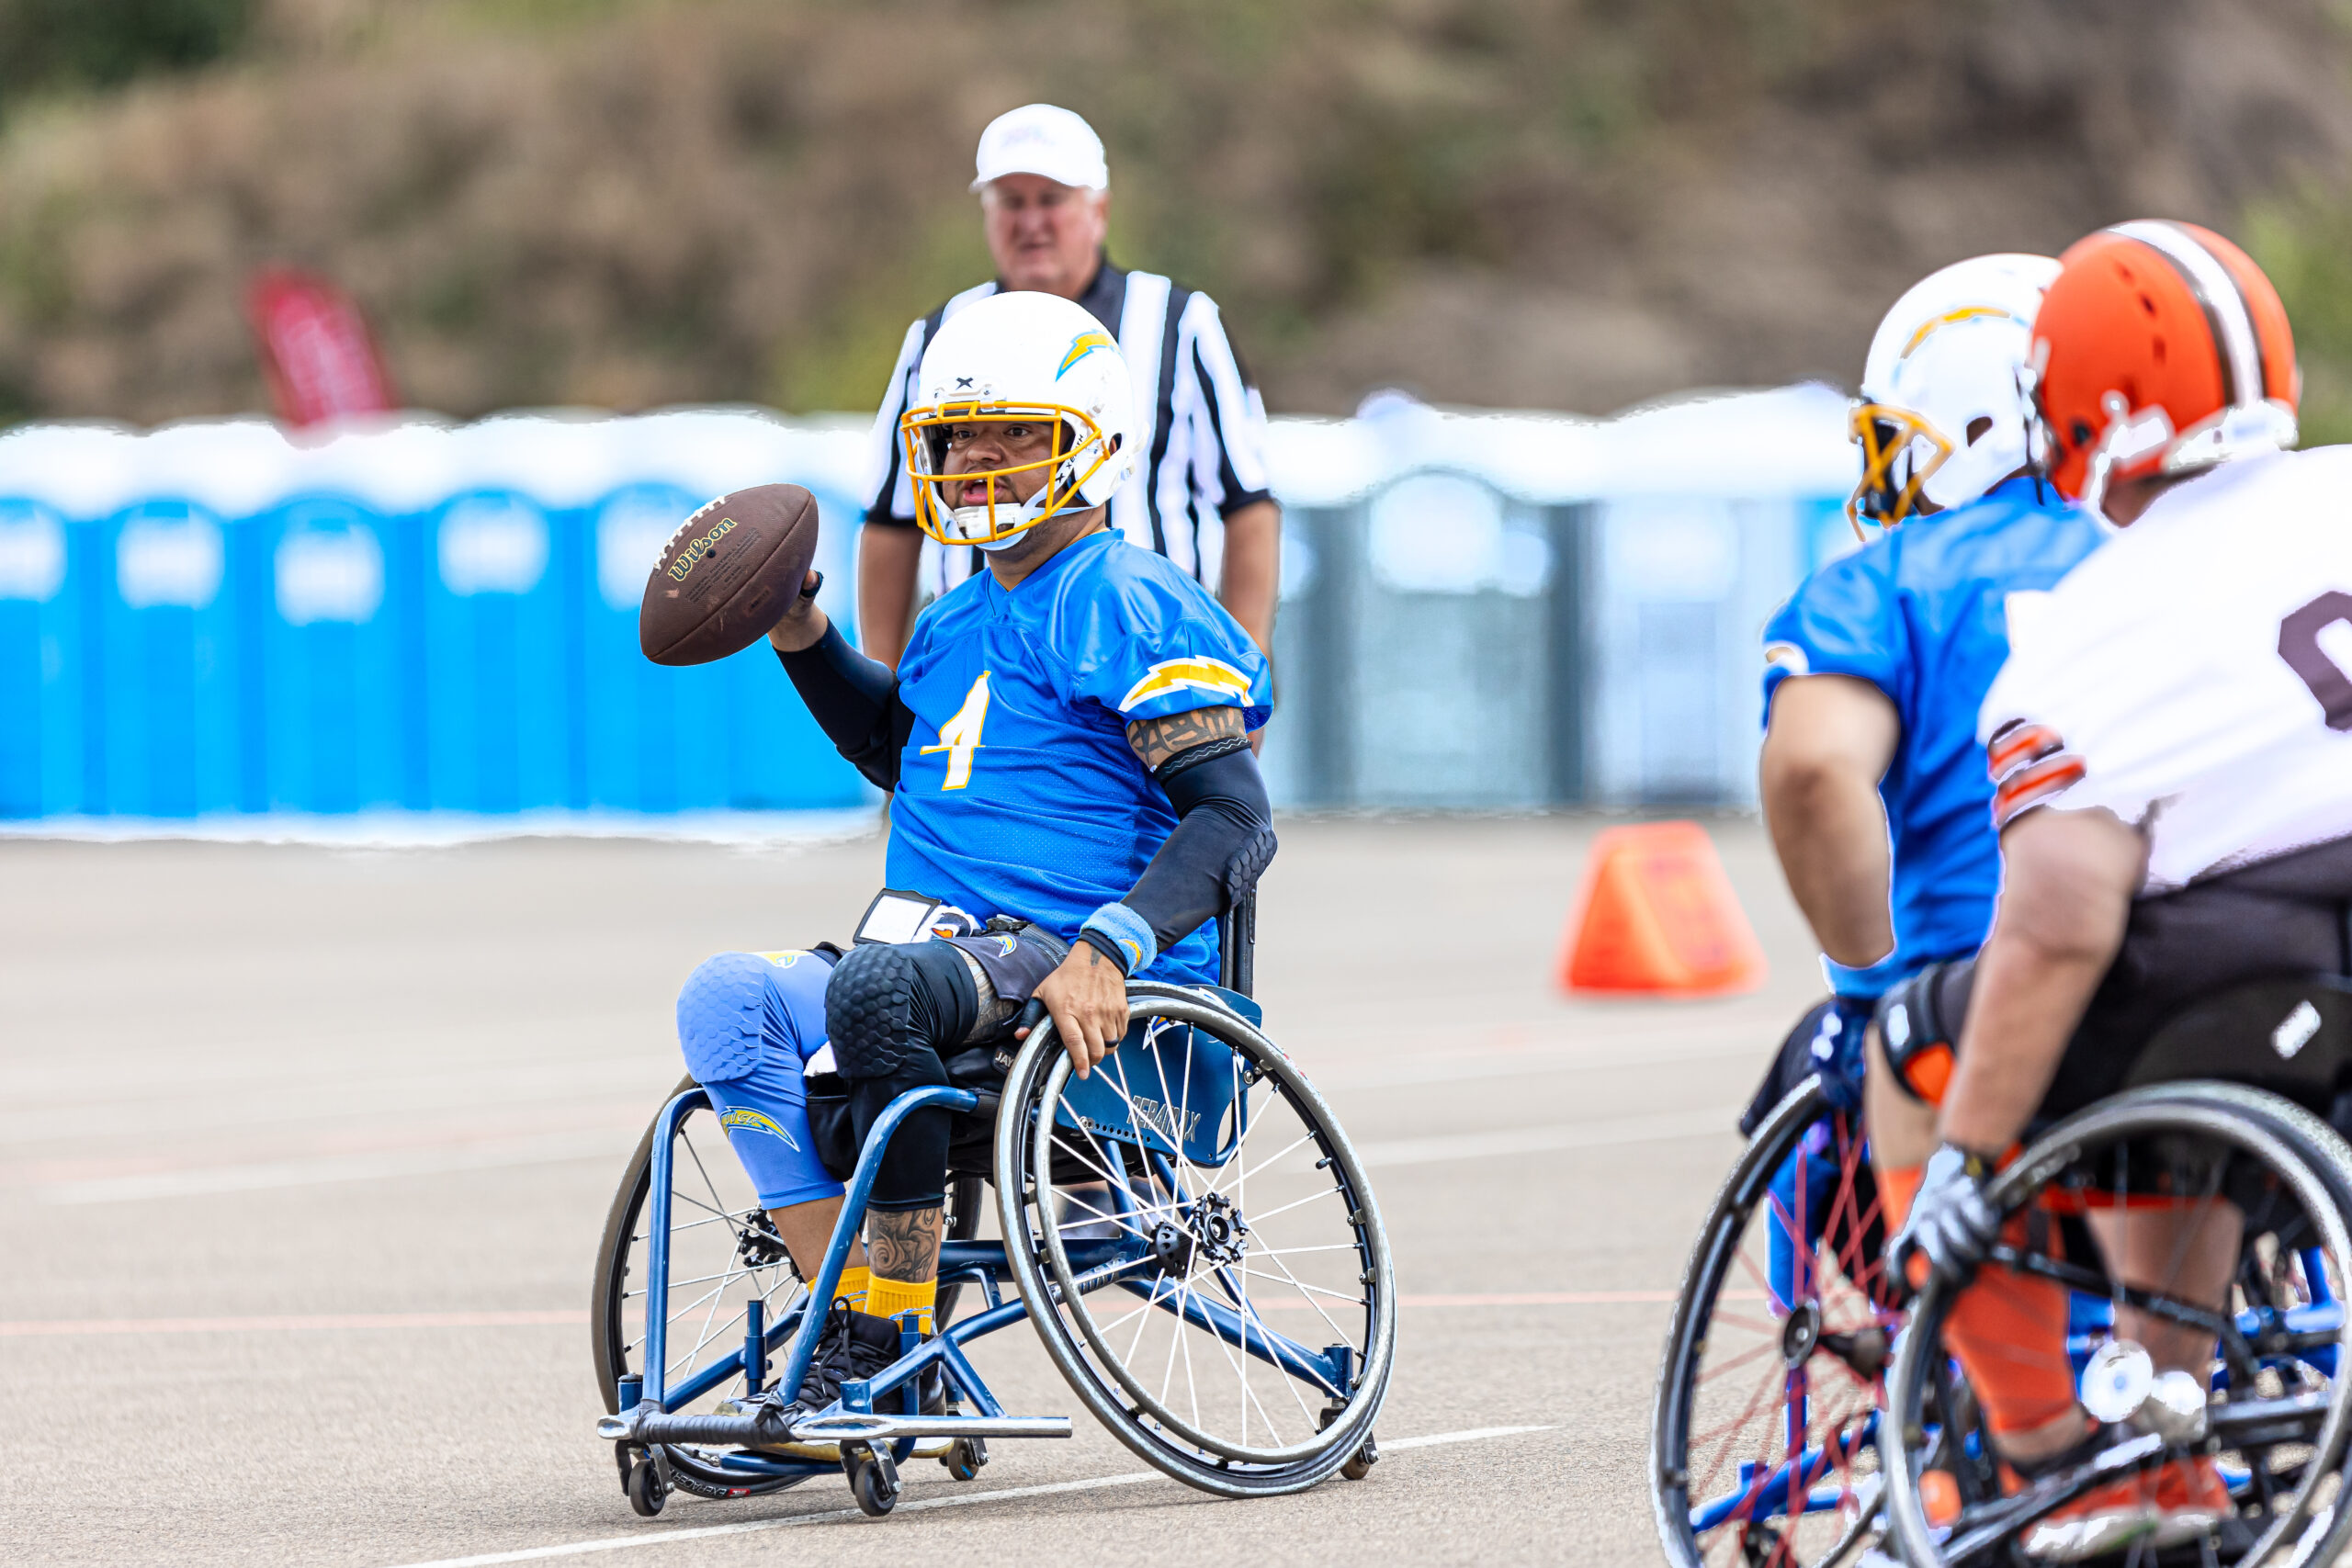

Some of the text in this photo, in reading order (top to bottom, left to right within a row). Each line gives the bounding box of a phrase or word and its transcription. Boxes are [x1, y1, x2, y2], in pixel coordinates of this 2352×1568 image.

[1066, 434, 1084, 469] XETH
[667, 517, 738, 582] Wilson
[920, 671, 991, 791] 4
[995, 1052, 1014, 1067] JAY
